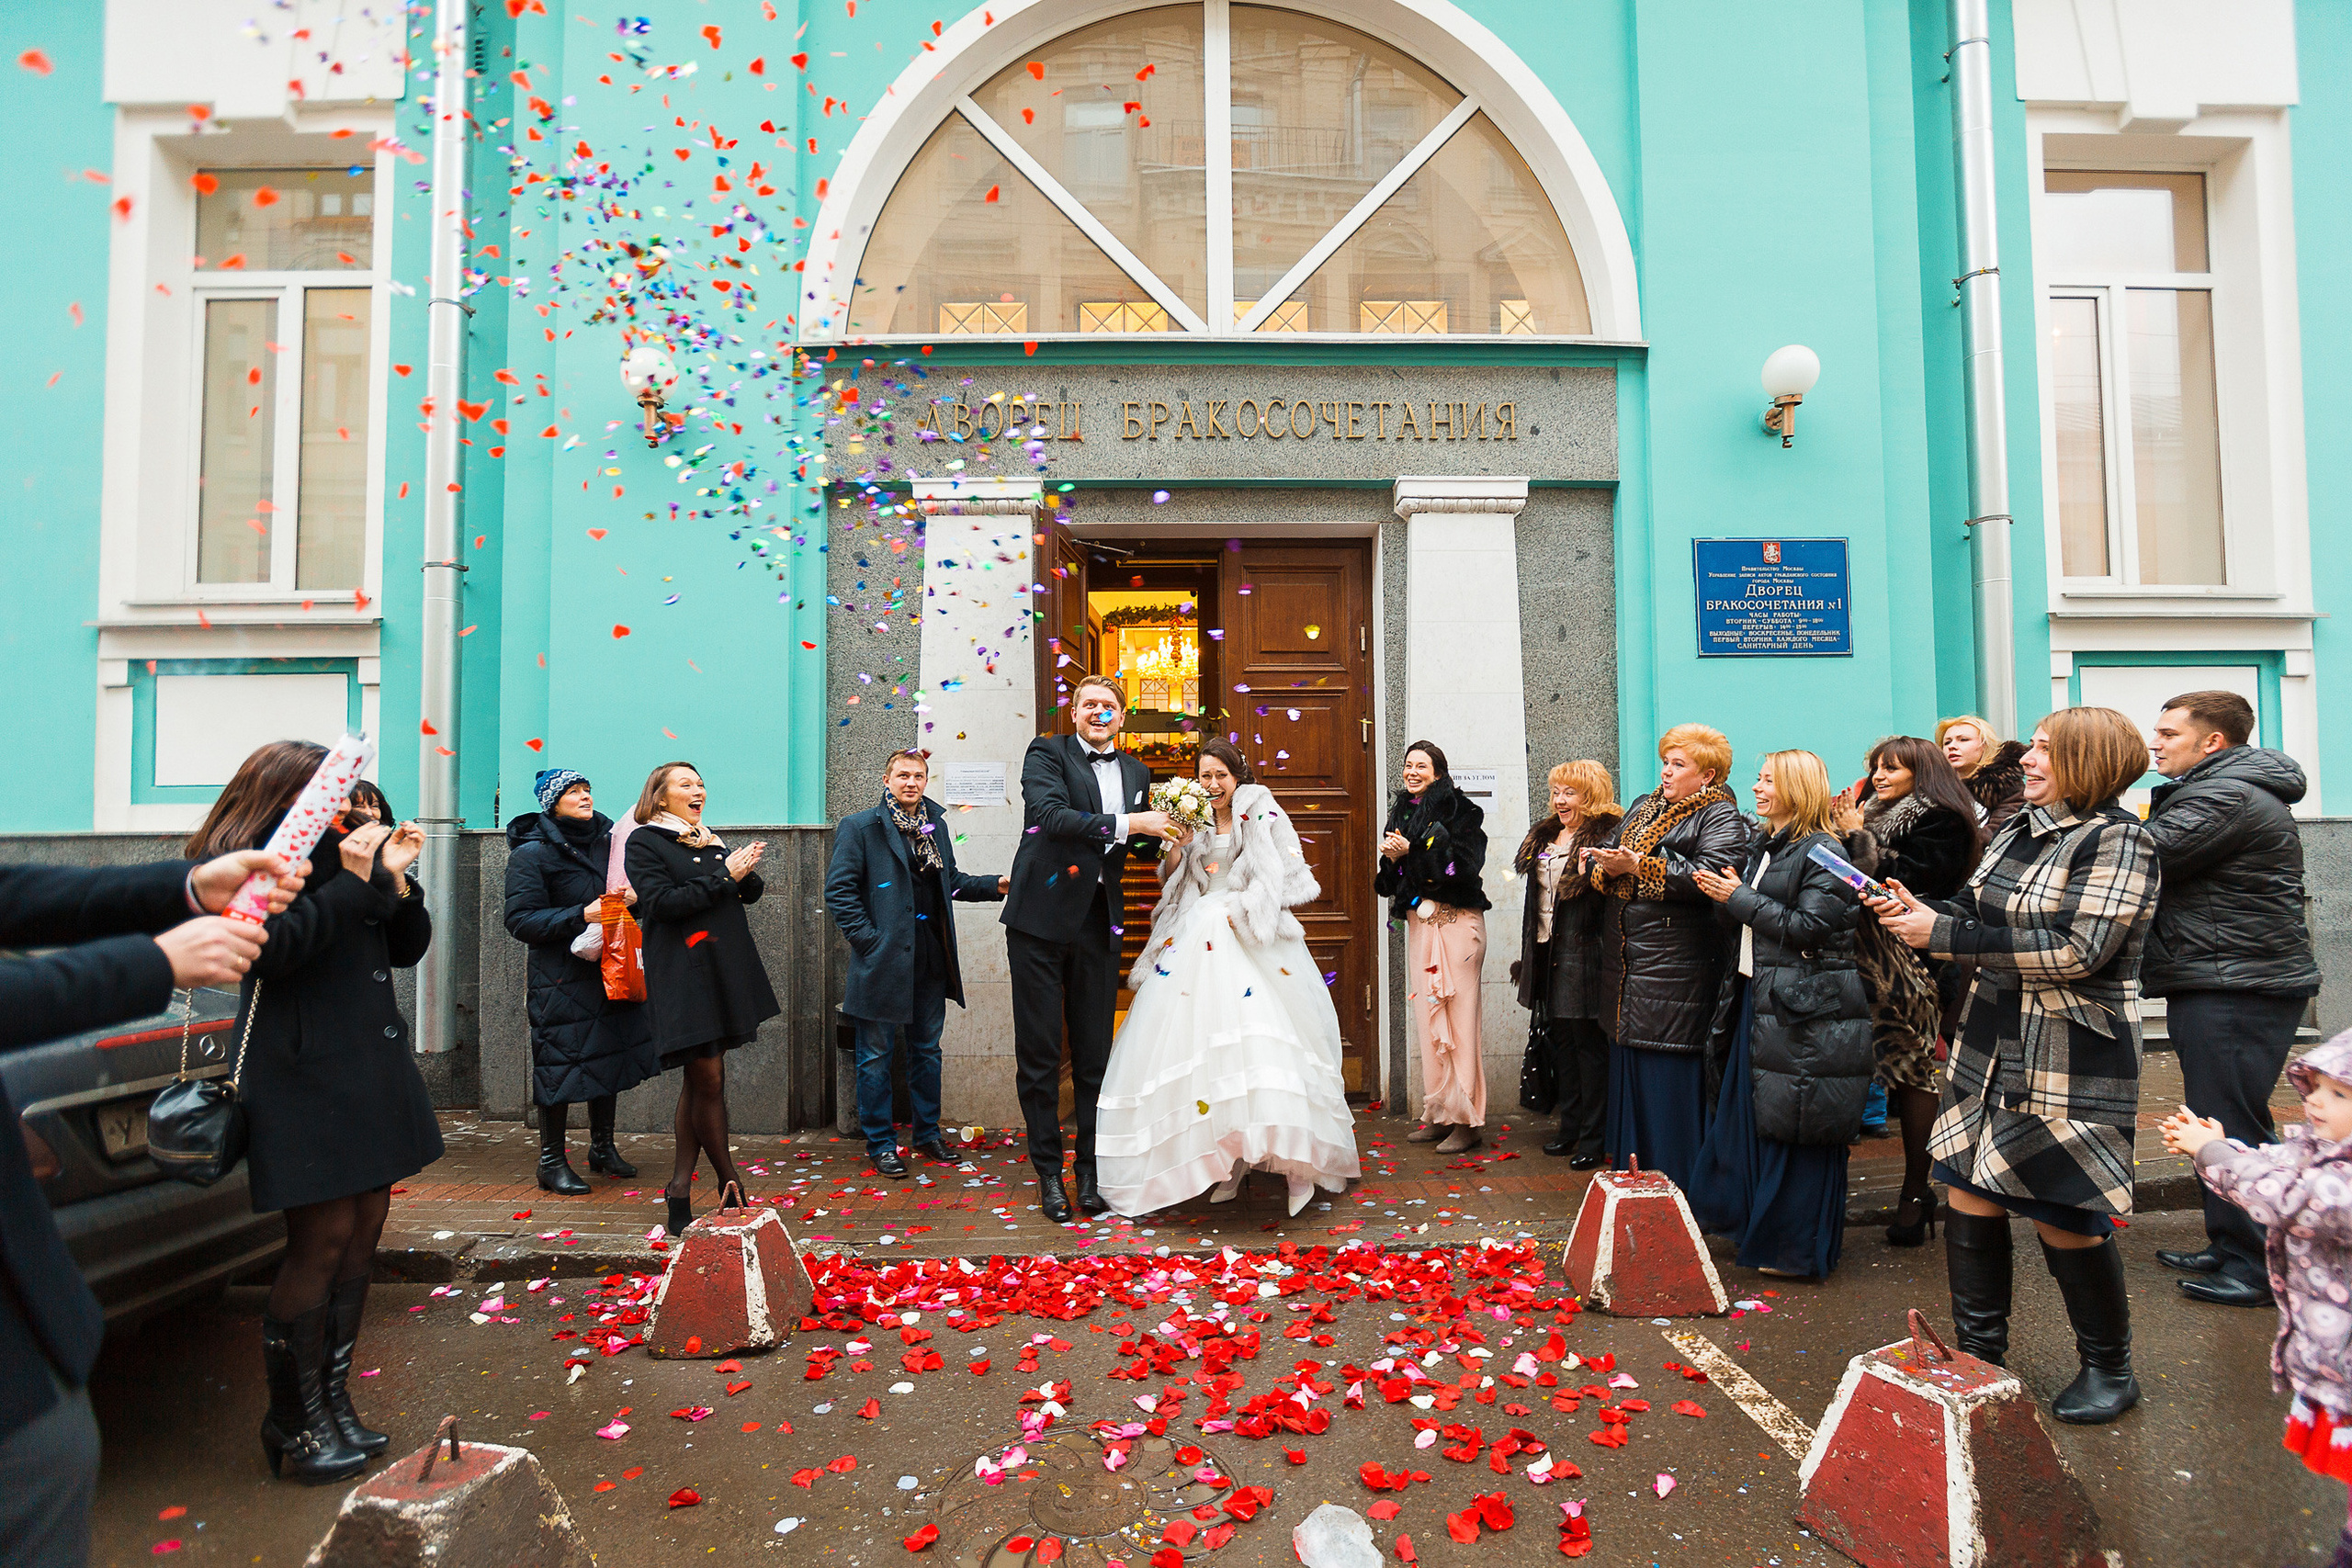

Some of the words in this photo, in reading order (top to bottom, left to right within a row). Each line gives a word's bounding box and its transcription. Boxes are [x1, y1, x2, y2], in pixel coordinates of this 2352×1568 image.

[919, 401, 1083, 444] ДВОРЕЦ
[1121, 399, 1518, 440] БРАКОСОЧЕТАНИЯ
[1706, 600, 1824, 611] БРАКОСОЧЕТАНИЯ
